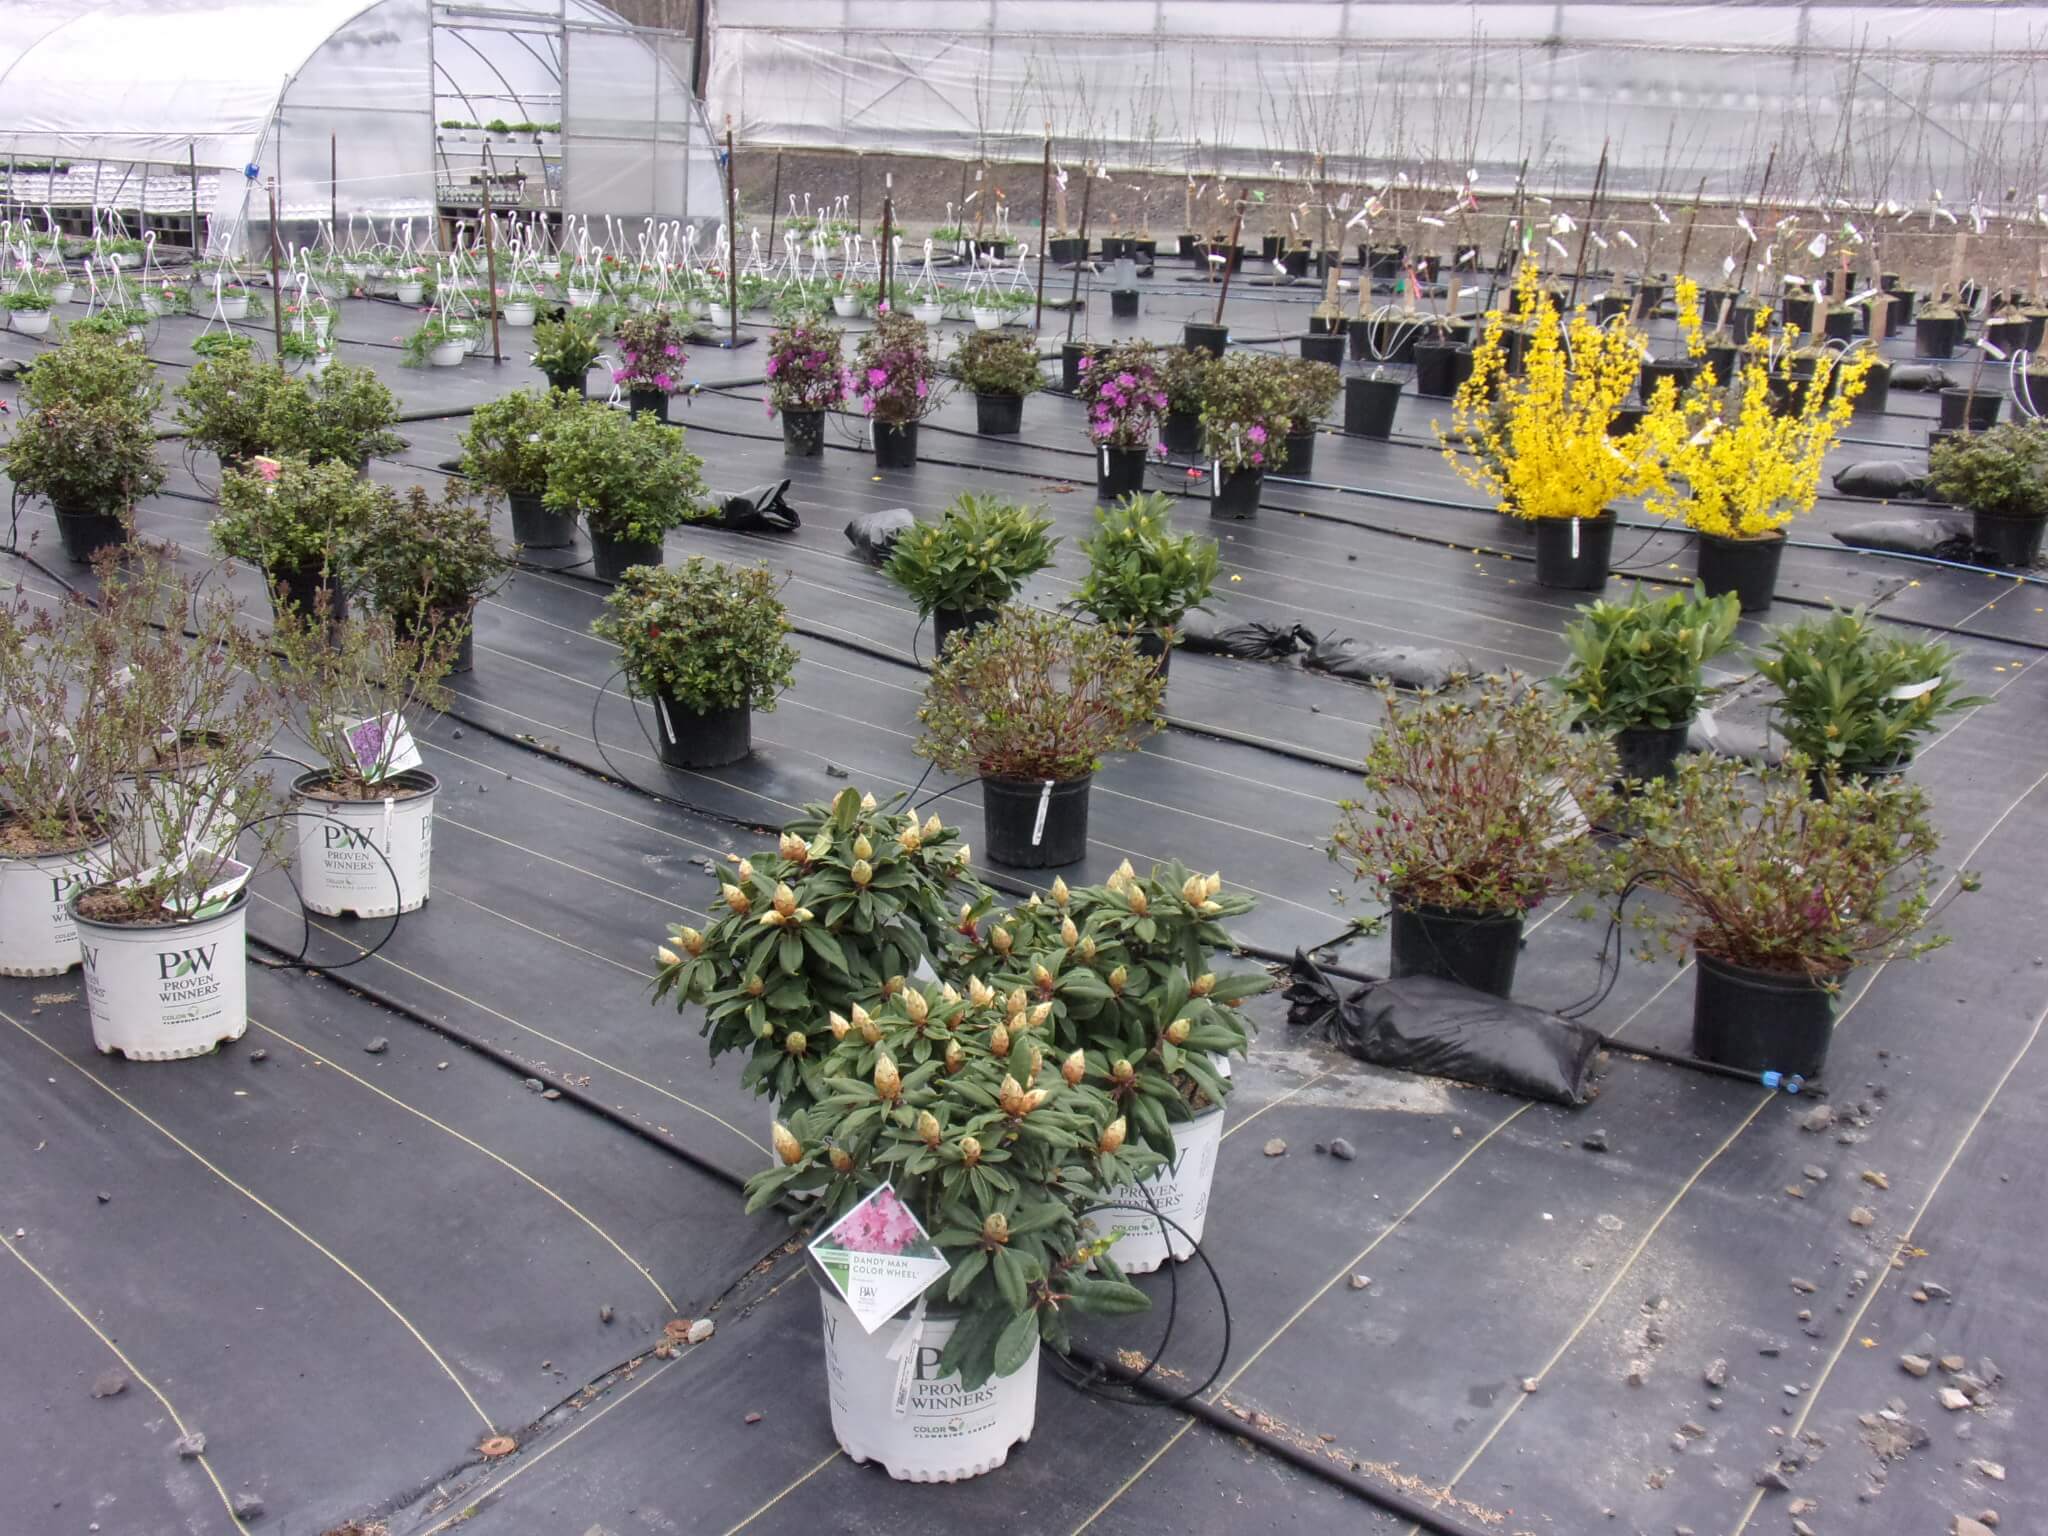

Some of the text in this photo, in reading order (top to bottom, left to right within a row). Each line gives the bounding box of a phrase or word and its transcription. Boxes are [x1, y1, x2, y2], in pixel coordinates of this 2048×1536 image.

[327, 851, 369, 861] PROVEN
[325, 859, 374, 870] WINNERS
[156, 943, 218, 979] PW
[164, 974, 214, 991] PROVEN
[159, 984, 219, 1002] WINNERS
[853, 1256, 884, 1265] DANDY
[853, 1265, 884, 1275] COLOR
[886, 1269, 917, 1280] WHEEL
[919, 1383, 962, 1396] PROV
[911, 1388, 993, 1410] WINNERS
